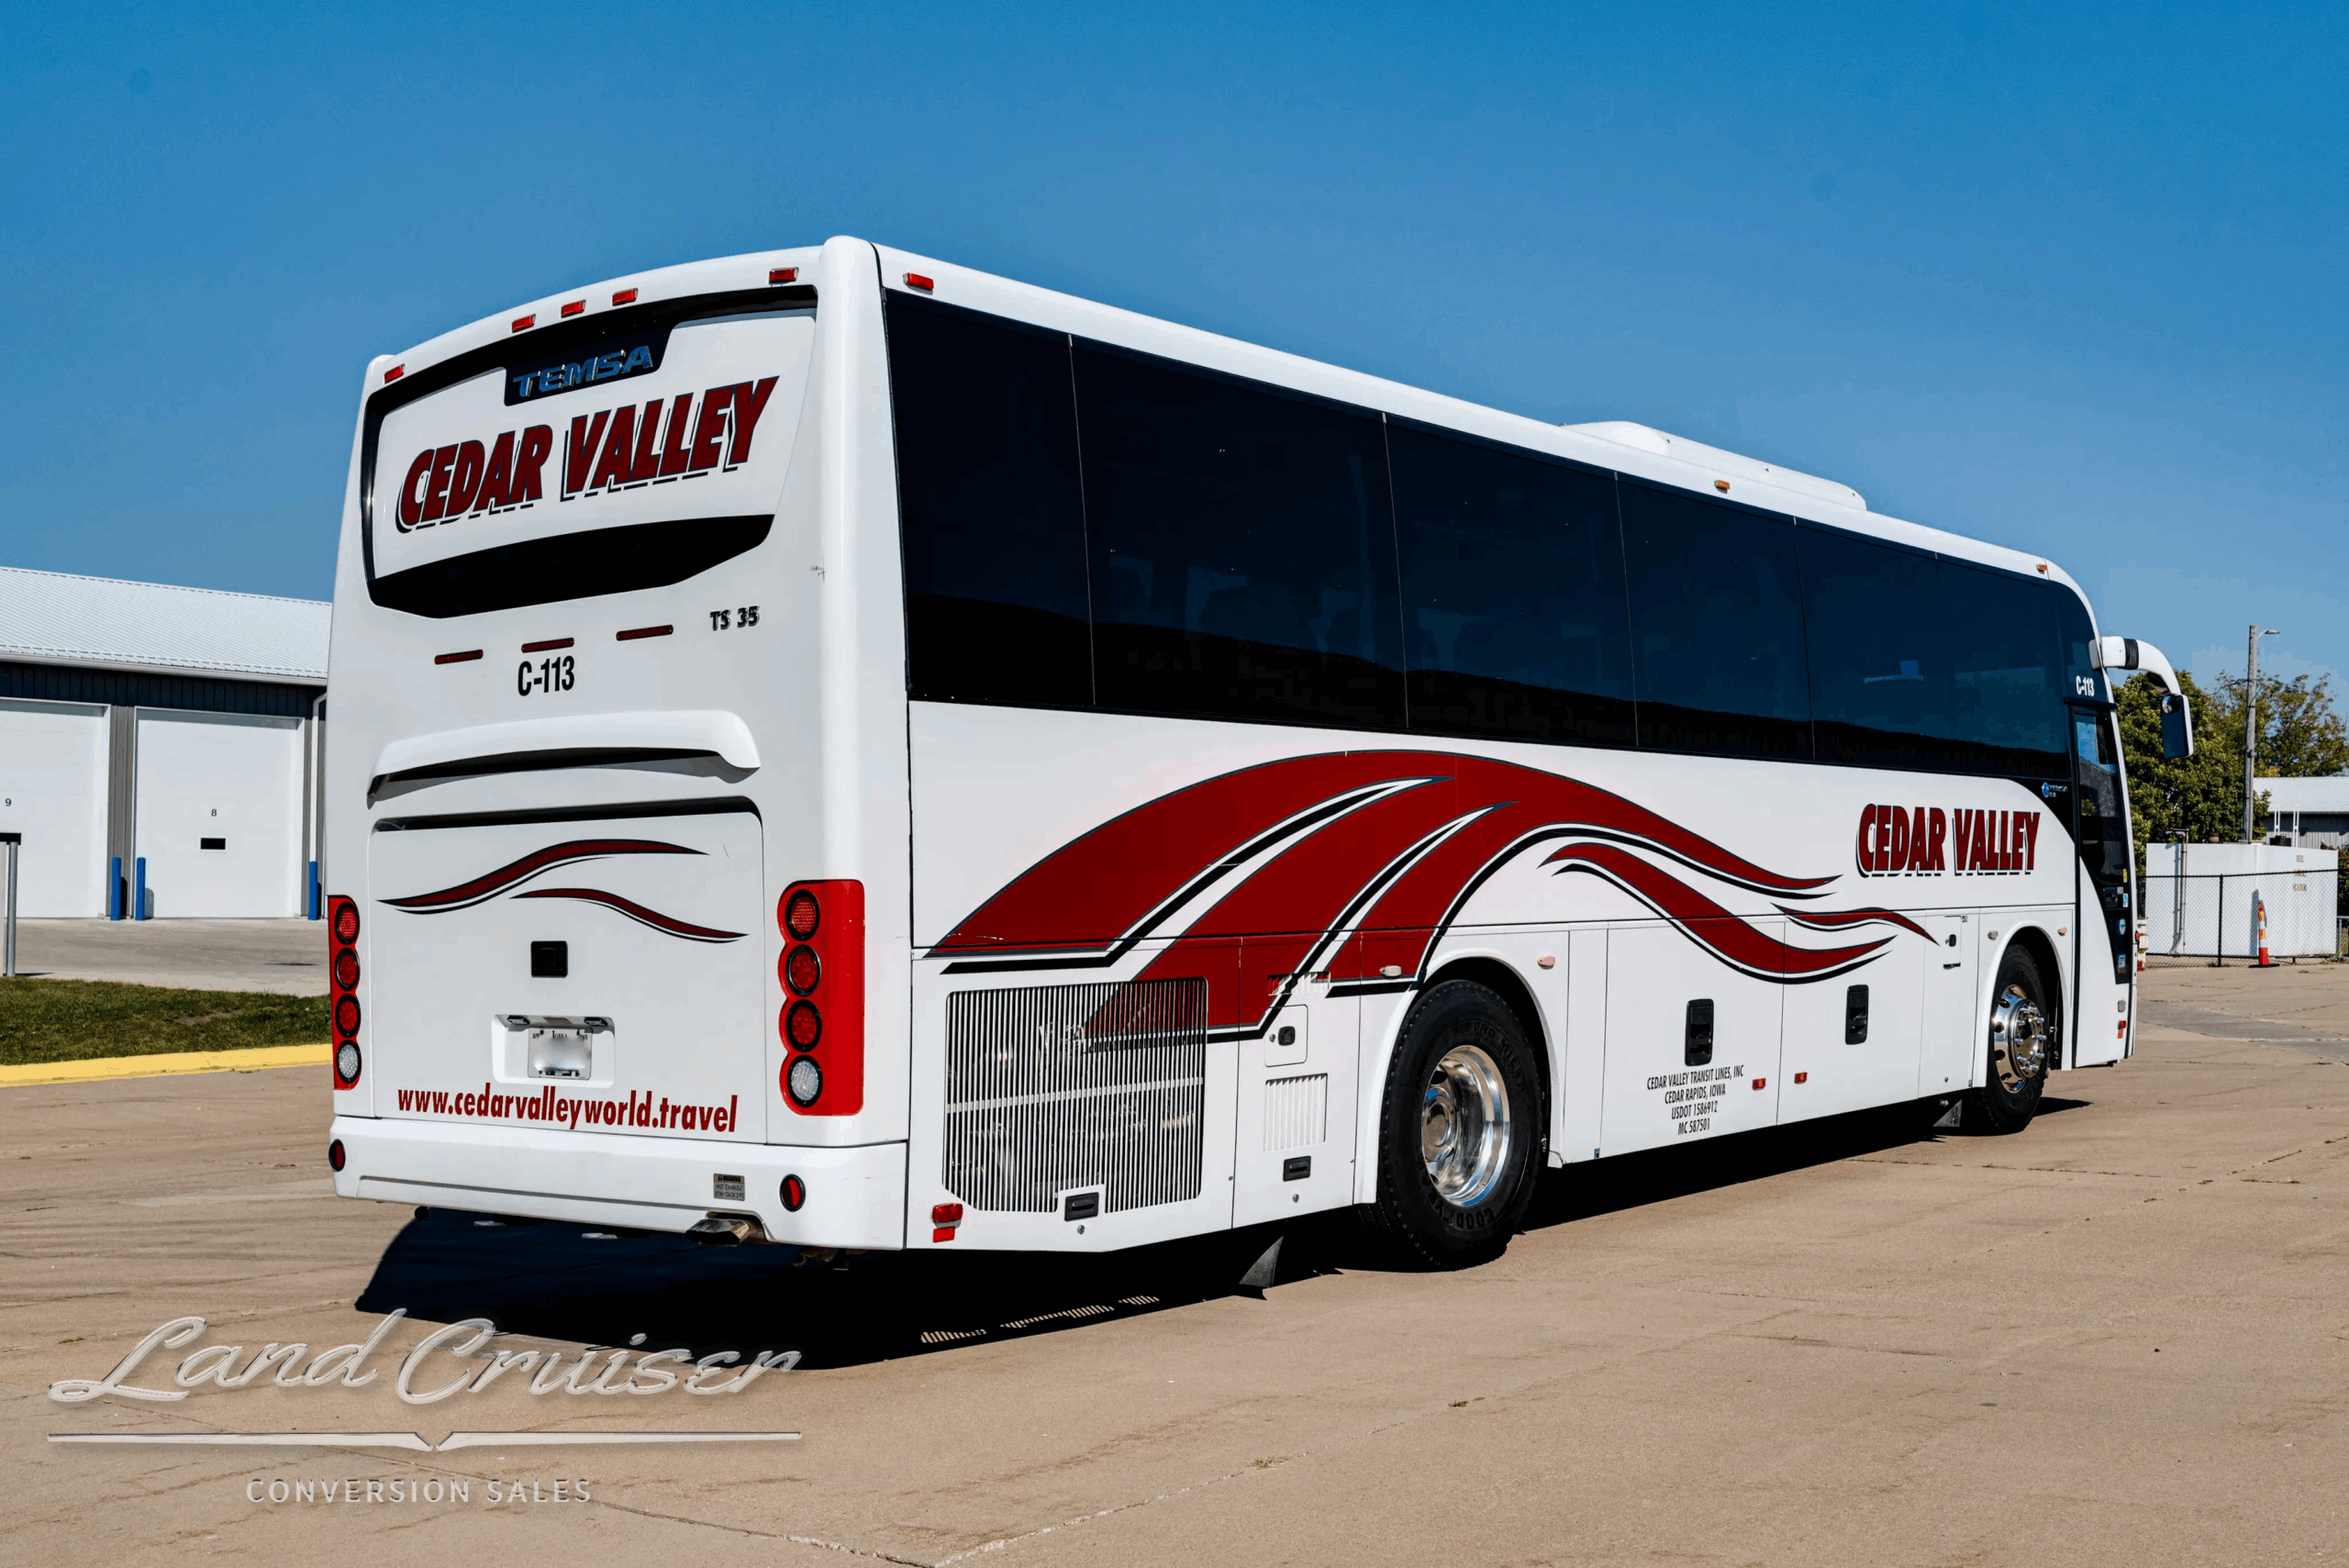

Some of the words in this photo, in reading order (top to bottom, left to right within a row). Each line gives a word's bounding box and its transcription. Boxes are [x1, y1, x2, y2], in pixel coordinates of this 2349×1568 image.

[512, 345, 653, 397] TEMSA
[396, 424, 553, 532] CEDAR
[562, 375, 780, 501] VALLEY
[709, 608, 730, 630] TS
[737, 606, 760, 628] 35
[518, 655, 575, 696] C-113
[2076, 675, 2095, 697] C-113
[5, 798, 12, 806] 9
[211, 808, 217, 817] 8
[1855, 803, 1946, 877] CEDAR
[1952, 808, 2041, 876] VALLEY
[1647, 1074, 1667, 1090] CEDAR
[1668, 1071, 1688, 1086] VALLEY
[1690, 1068, 1714, 1084] TRANSIT
[1715, 1065, 1732, 1081] LINES,
[1733, 1064, 1744, 1078] INC
[1664, 1089, 1684, 1105] CEDAR
[1686, 1085, 1708, 1101] RAPIDS,
[1709, 1084, 1726, 1097] IOWA
[397, 1083, 738, 1133] www.cedarvalleyworld.travel
[1671, 1105, 1692, 1120] USDOT
[1693, 1100, 1718, 1117] 1586912
[1677, 1122, 1688, 1135] MC
[1689, 1118, 1710, 1133] 587501
